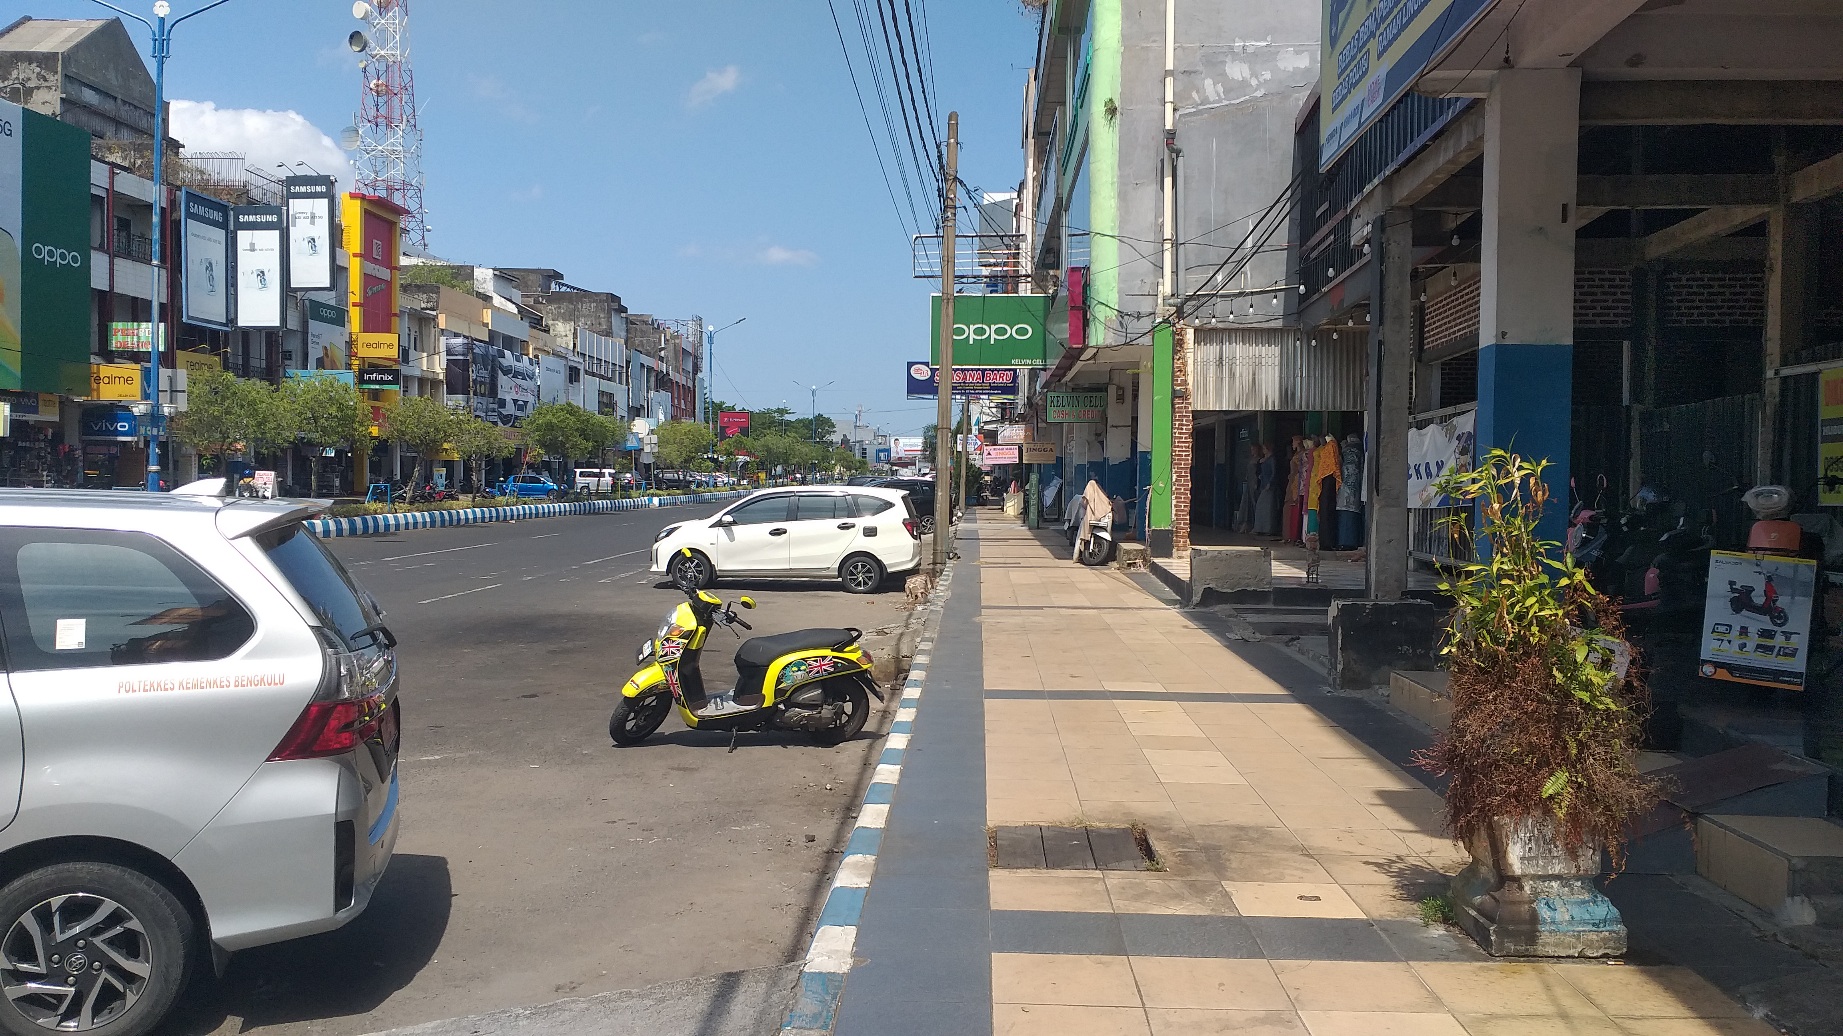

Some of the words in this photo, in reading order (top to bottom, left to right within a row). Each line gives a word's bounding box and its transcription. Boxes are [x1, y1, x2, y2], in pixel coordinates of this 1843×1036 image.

[290, 185, 326, 193] SAMSUNG
[189, 202, 223, 222] SAMSUNG
[239, 214, 278, 222] SAMSUNG
[361, 341, 394, 350] realme
[186, 360, 214, 371] realme
[363, 373, 394, 381] Infinix
[984, 370, 1014, 382] BARU
[1050, 395, 1080, 408] KELVIN
[1083, 395, 1104, 408] CELL
[1052, 409, 1069, 419] CASH
[91, 421, 129, 431] vivo
[118, 678, 175, 694] POLTEKKES
[178, 675, 231, 691] KEMENKES
[234, 672, 285, 688] BENGKULU
